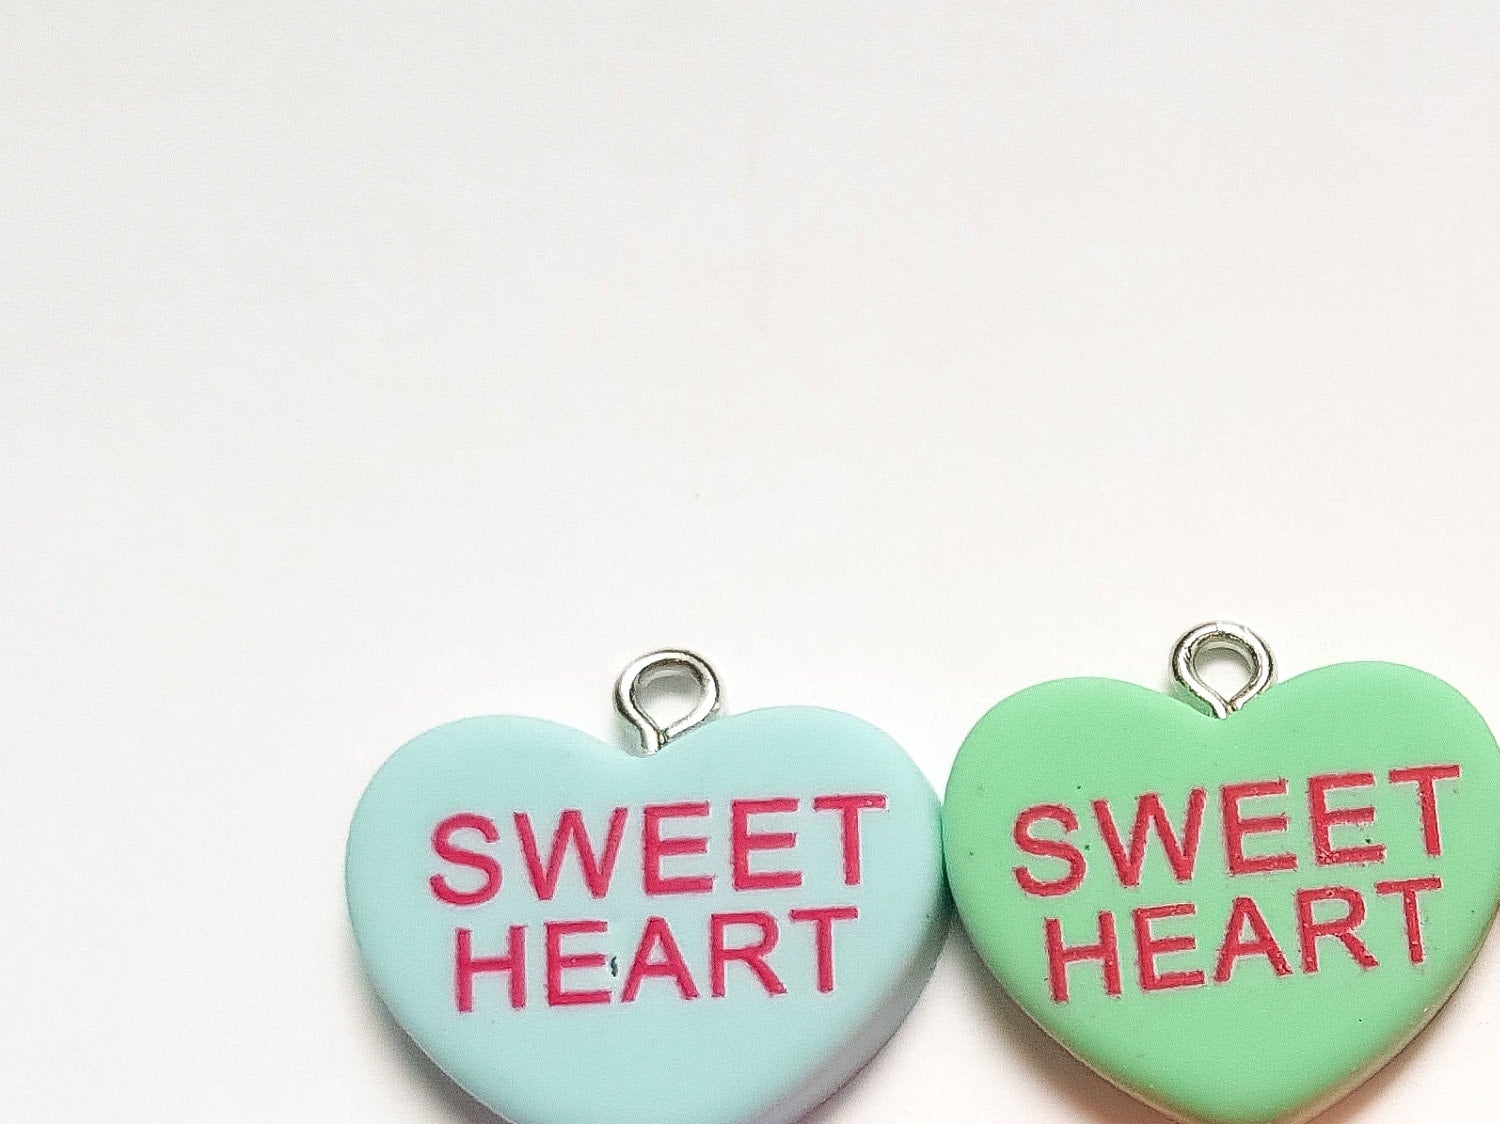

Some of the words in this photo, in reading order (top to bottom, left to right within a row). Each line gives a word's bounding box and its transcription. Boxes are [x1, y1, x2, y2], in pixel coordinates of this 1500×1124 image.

[427, 793, 888, 908] SWEET
[1011, 763, 1461, 899] SWEET
[453, 905, 860, 1014] HEART
[1042, 875, 1443, 1006] HEART
